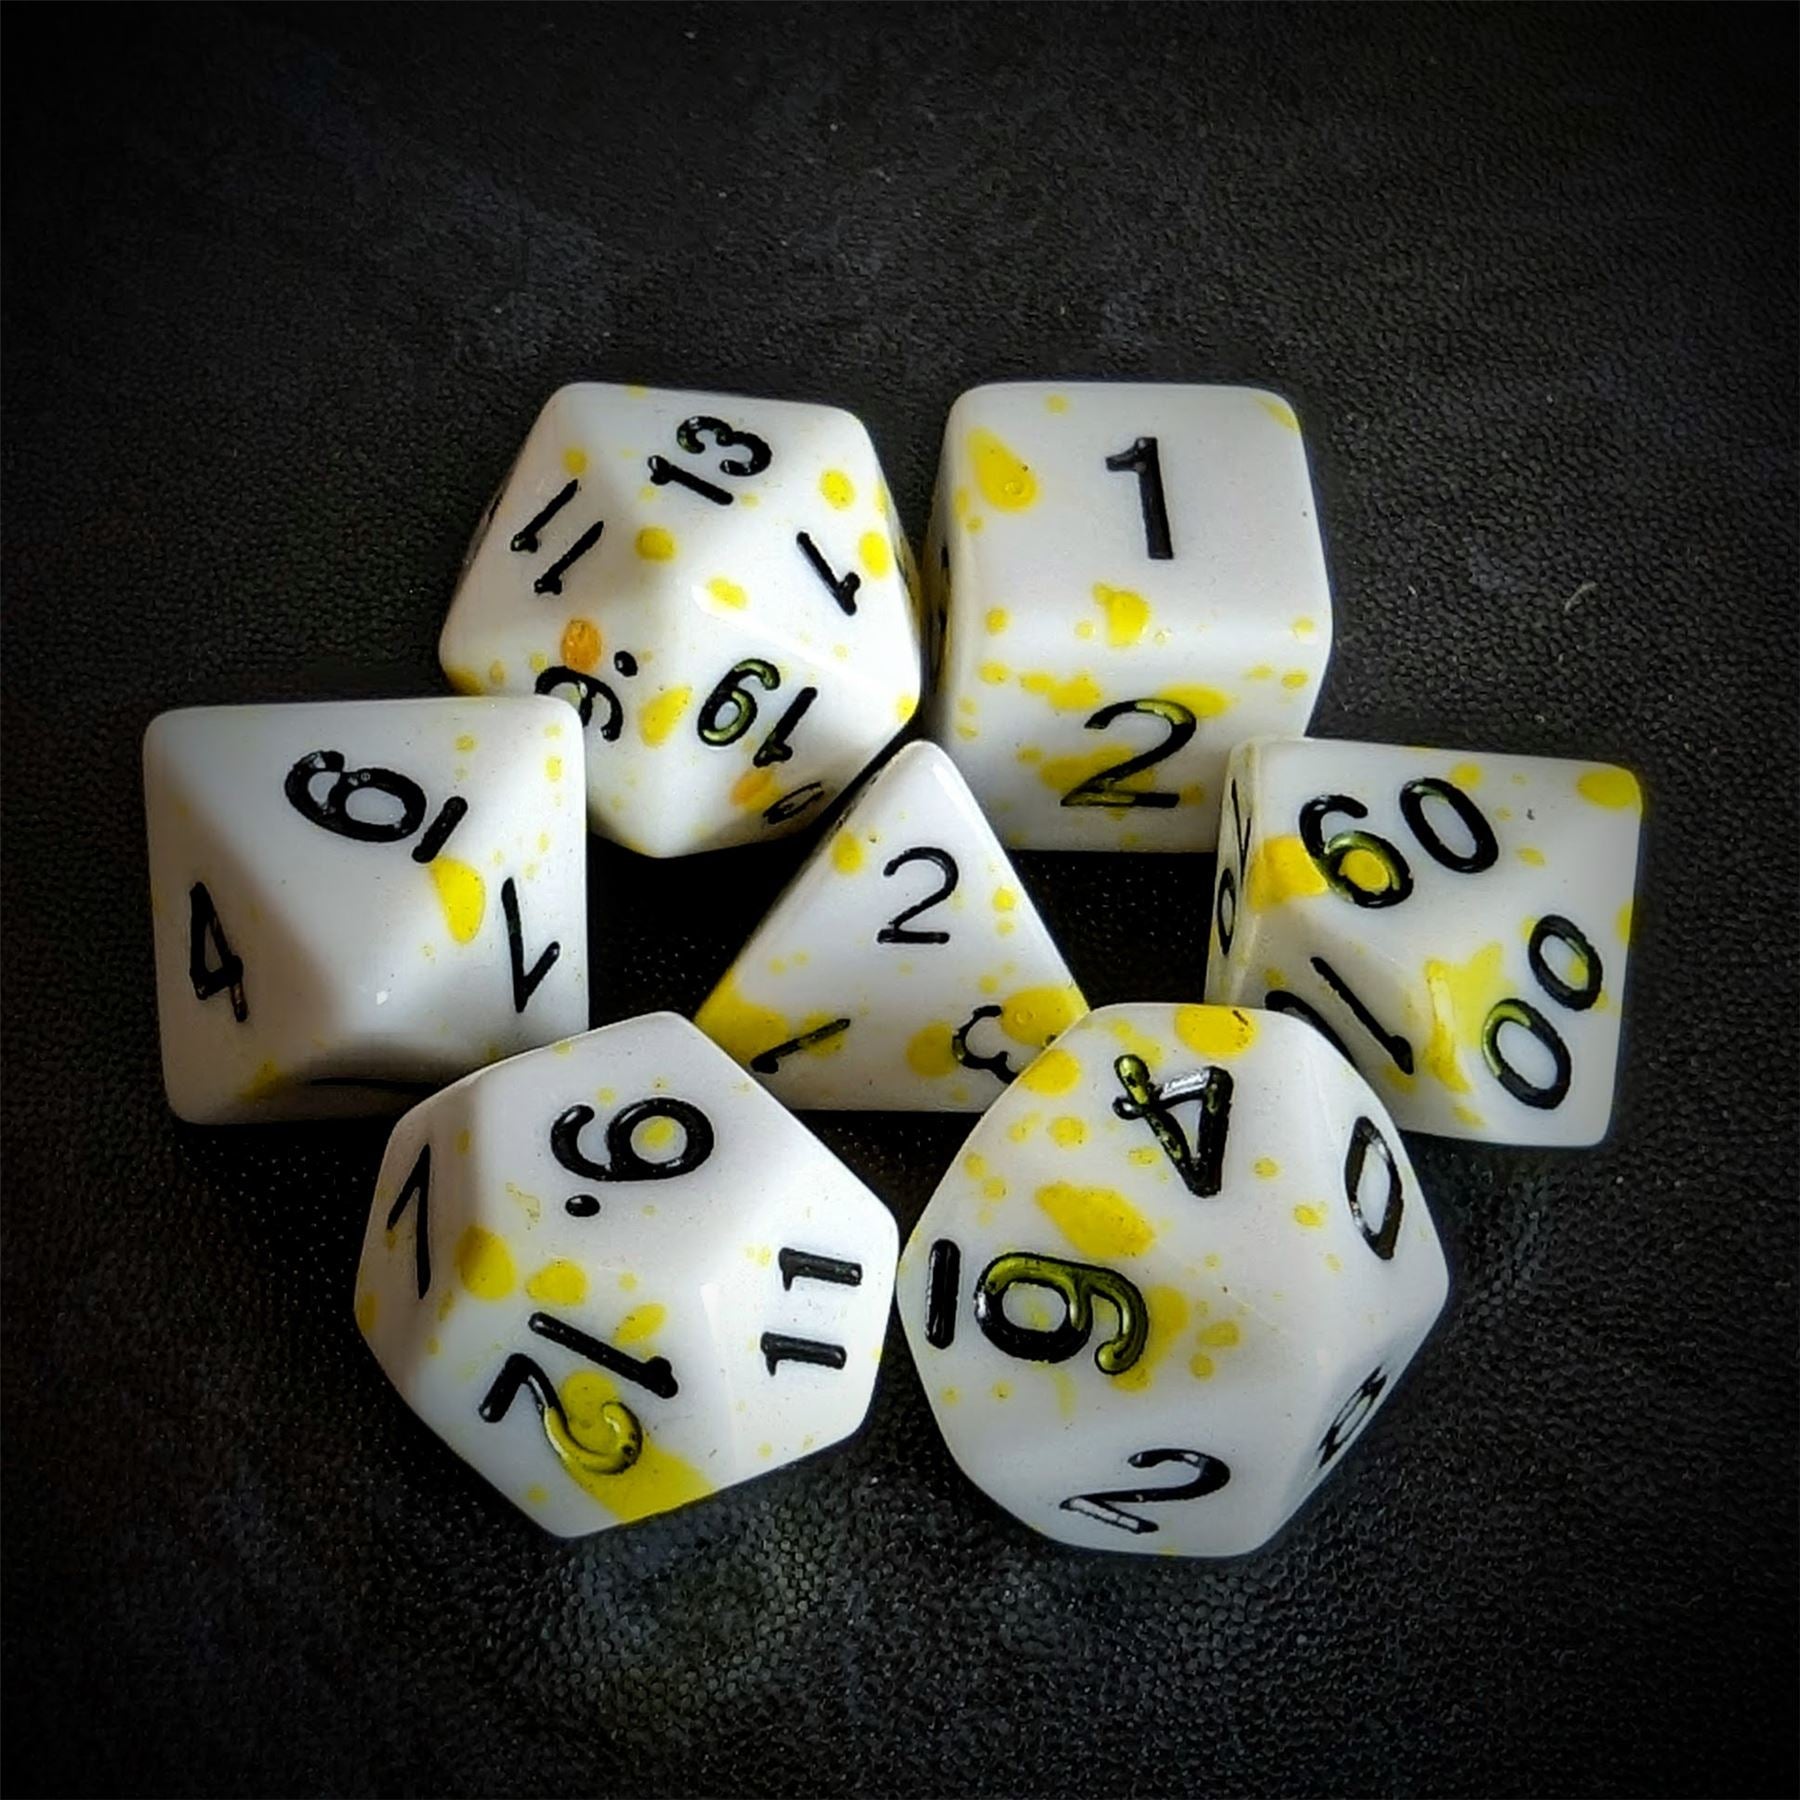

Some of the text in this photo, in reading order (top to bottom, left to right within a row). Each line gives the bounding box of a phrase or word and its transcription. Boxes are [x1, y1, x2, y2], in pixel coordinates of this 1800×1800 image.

[647, 415, 772, 506] 13
[1106, 437, 1174, 560] 1
[510, 479, 604, 595] 11
[697, 658, 818, 767] 19
[1060, 698, 1197, 808] 2
[877, 846, 959, 944] 2
[1299, 777, 1500, 908] 60
[189, 881, 249, 1023] 4
[1482, 914, 1604, 1110] 00
[750, 1018, 851, 1074] 1
[1112, 1054, 1235, 1198] 4
[1345, 1116, 1404, 1260] 0
[760, 1247, 863, 1377] 11
[478, 1311, 679, 1476] 12
[1060, 1448, 1231, 1534] 2
